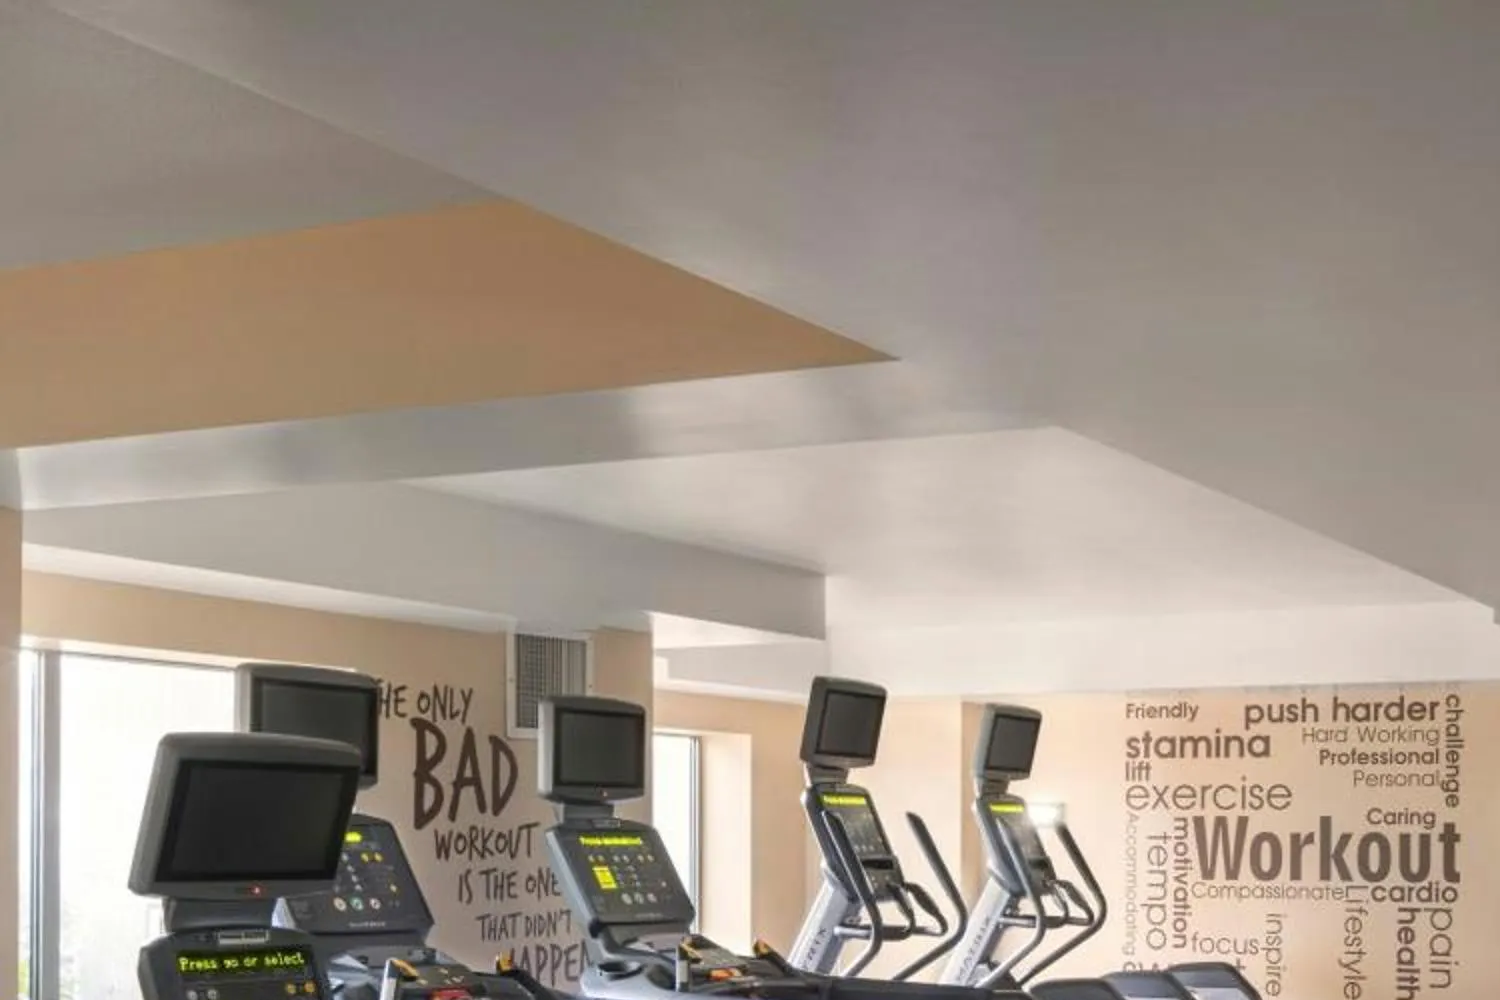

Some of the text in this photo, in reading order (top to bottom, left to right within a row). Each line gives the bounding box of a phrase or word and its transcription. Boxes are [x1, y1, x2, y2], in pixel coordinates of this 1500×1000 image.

[371, 679, 474, 725] HE ONLY
[1125, 701, 1199, 722] Friendly
[1244, 695, 1440, 730] push harder
[1125, 727, 1271, 758] stamina
[1302, 726, 1440, 746] Hard Working
[1441, 694, 1464, 808] challenge
[410, 717, 518, 831] BAD
[1125, 760, 1152, 781] lift
[1319, 749, 1440, 766] Professional
[1125, 775, 1293, 811] exercise
[1353, 769, 1440, 788] Personal
[1367, 807, 1437, 829] Caring
[434, 821, 541, 861] WORKOUT
[1193, 815, 1461, 884] Workout
[458, 867, 562, 905] IS THE ONE
[1122, 811, 1140, 956] Accommodating
[1140, 832, 1172, 951] tempo
[1172, 817, 1193, 949] motivation
[1191, 881, 1345, 903] Compassionate
[1370, 880, 1459, 903] cardio
[475, 908, 573, 943] THAT DIDN'T
[1191, 931, 1260, 956] focus
[1338, 885, 1369, 1000] Lifestyle
[1260, 912, 1288, 997] inspire
[1423, 907, 1460, 989] pain
